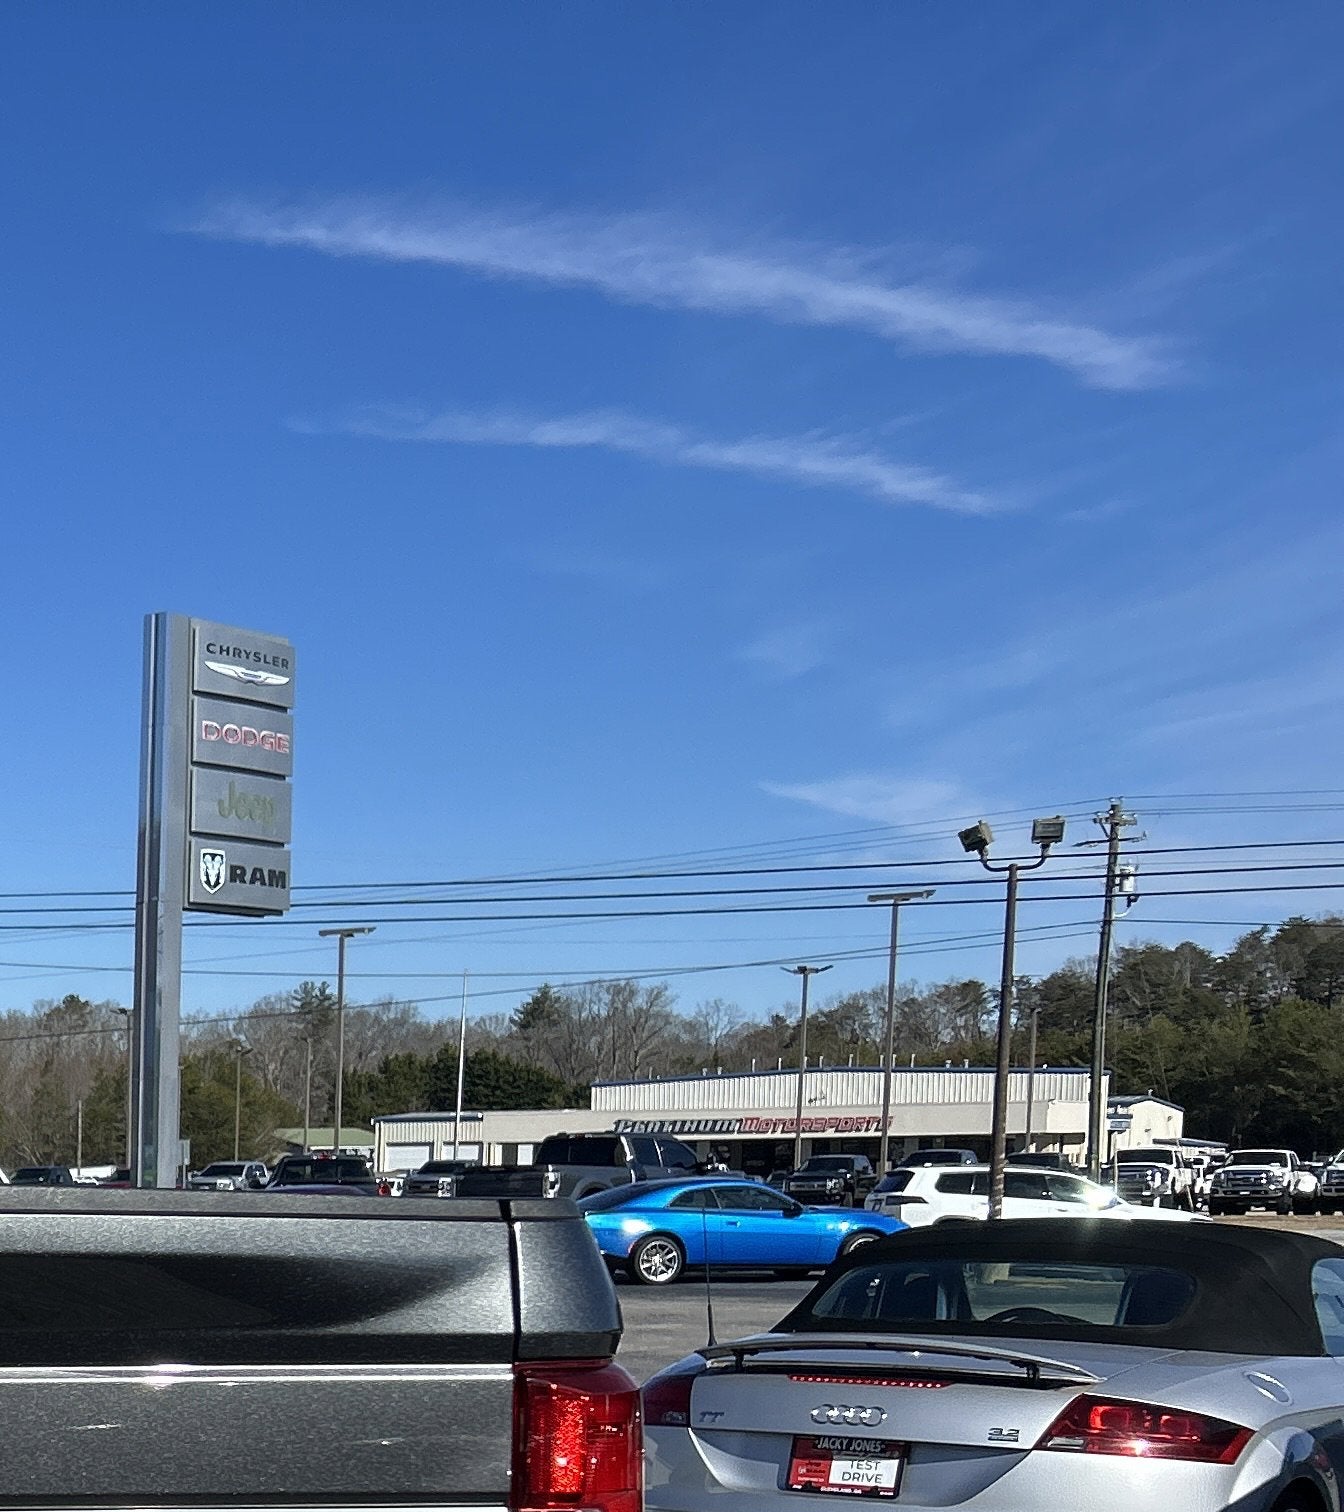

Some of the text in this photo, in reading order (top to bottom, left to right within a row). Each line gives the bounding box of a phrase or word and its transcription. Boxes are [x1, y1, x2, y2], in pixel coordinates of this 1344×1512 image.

[205, 642, 290, 670] CHRYSLER
[201, 719, 290, 754] DODGE
[229, 864, 287, 890] RAM
[699, 1411, 725, 1423] TT
[817, 1436, 882, 1453] JACKY JONES
[849, 1459, 881, 1471] TEST
[841, 1471, 884, 1484] DRIVE
